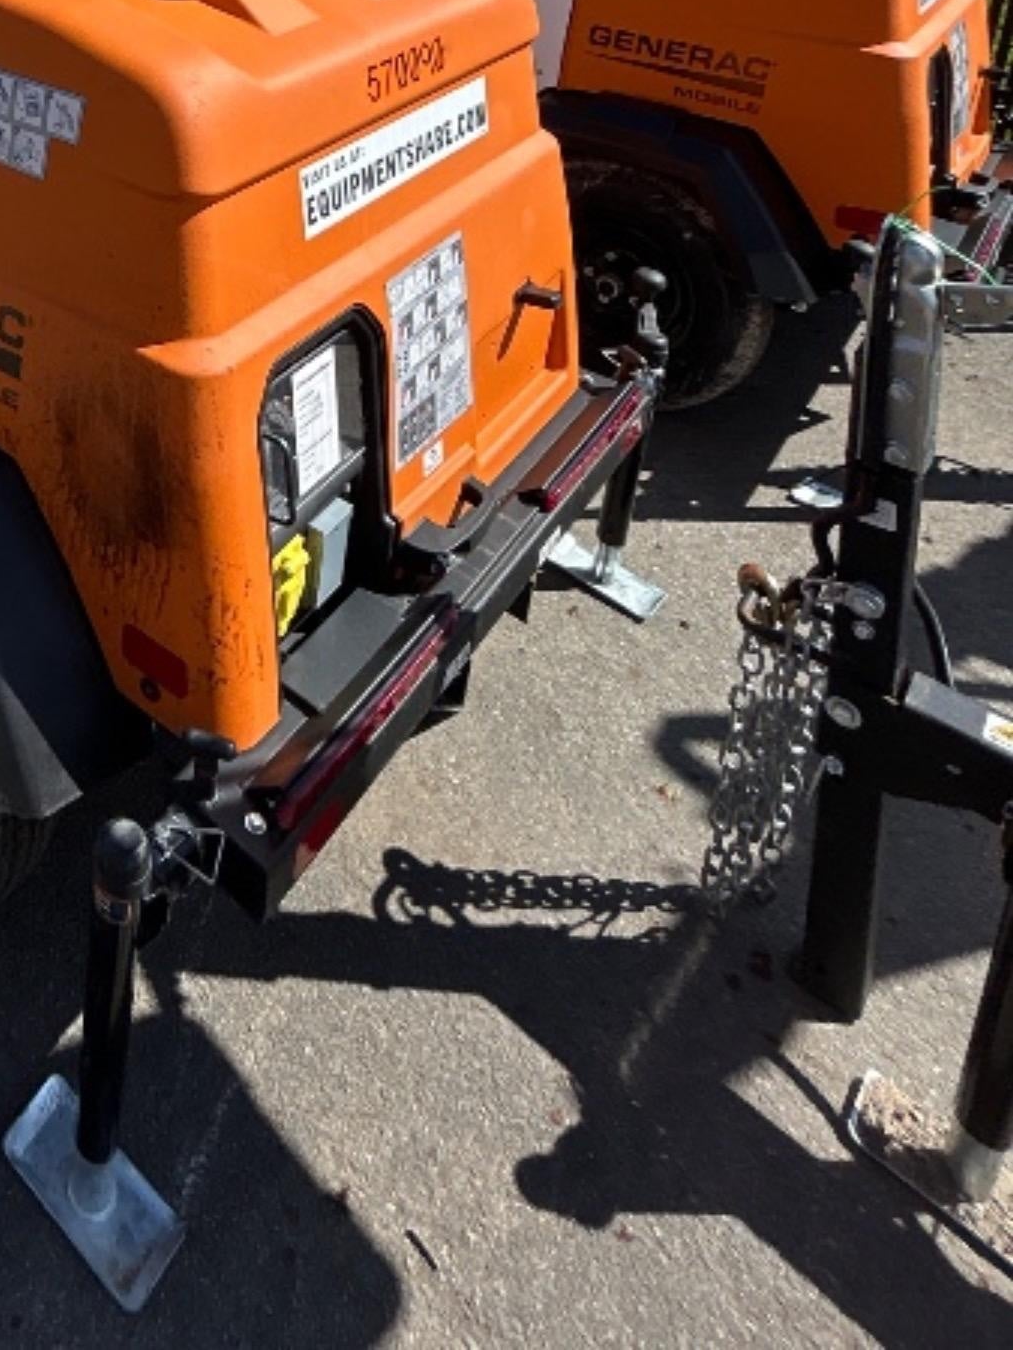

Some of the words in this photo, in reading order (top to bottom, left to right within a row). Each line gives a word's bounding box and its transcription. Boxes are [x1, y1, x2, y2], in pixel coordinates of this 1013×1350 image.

[590, 23, 771, 82] GENERAC
[673, 85, 762, 116] MOBILE
[306, 102, 487, 227] EQUIPMENTSHARE.COM
